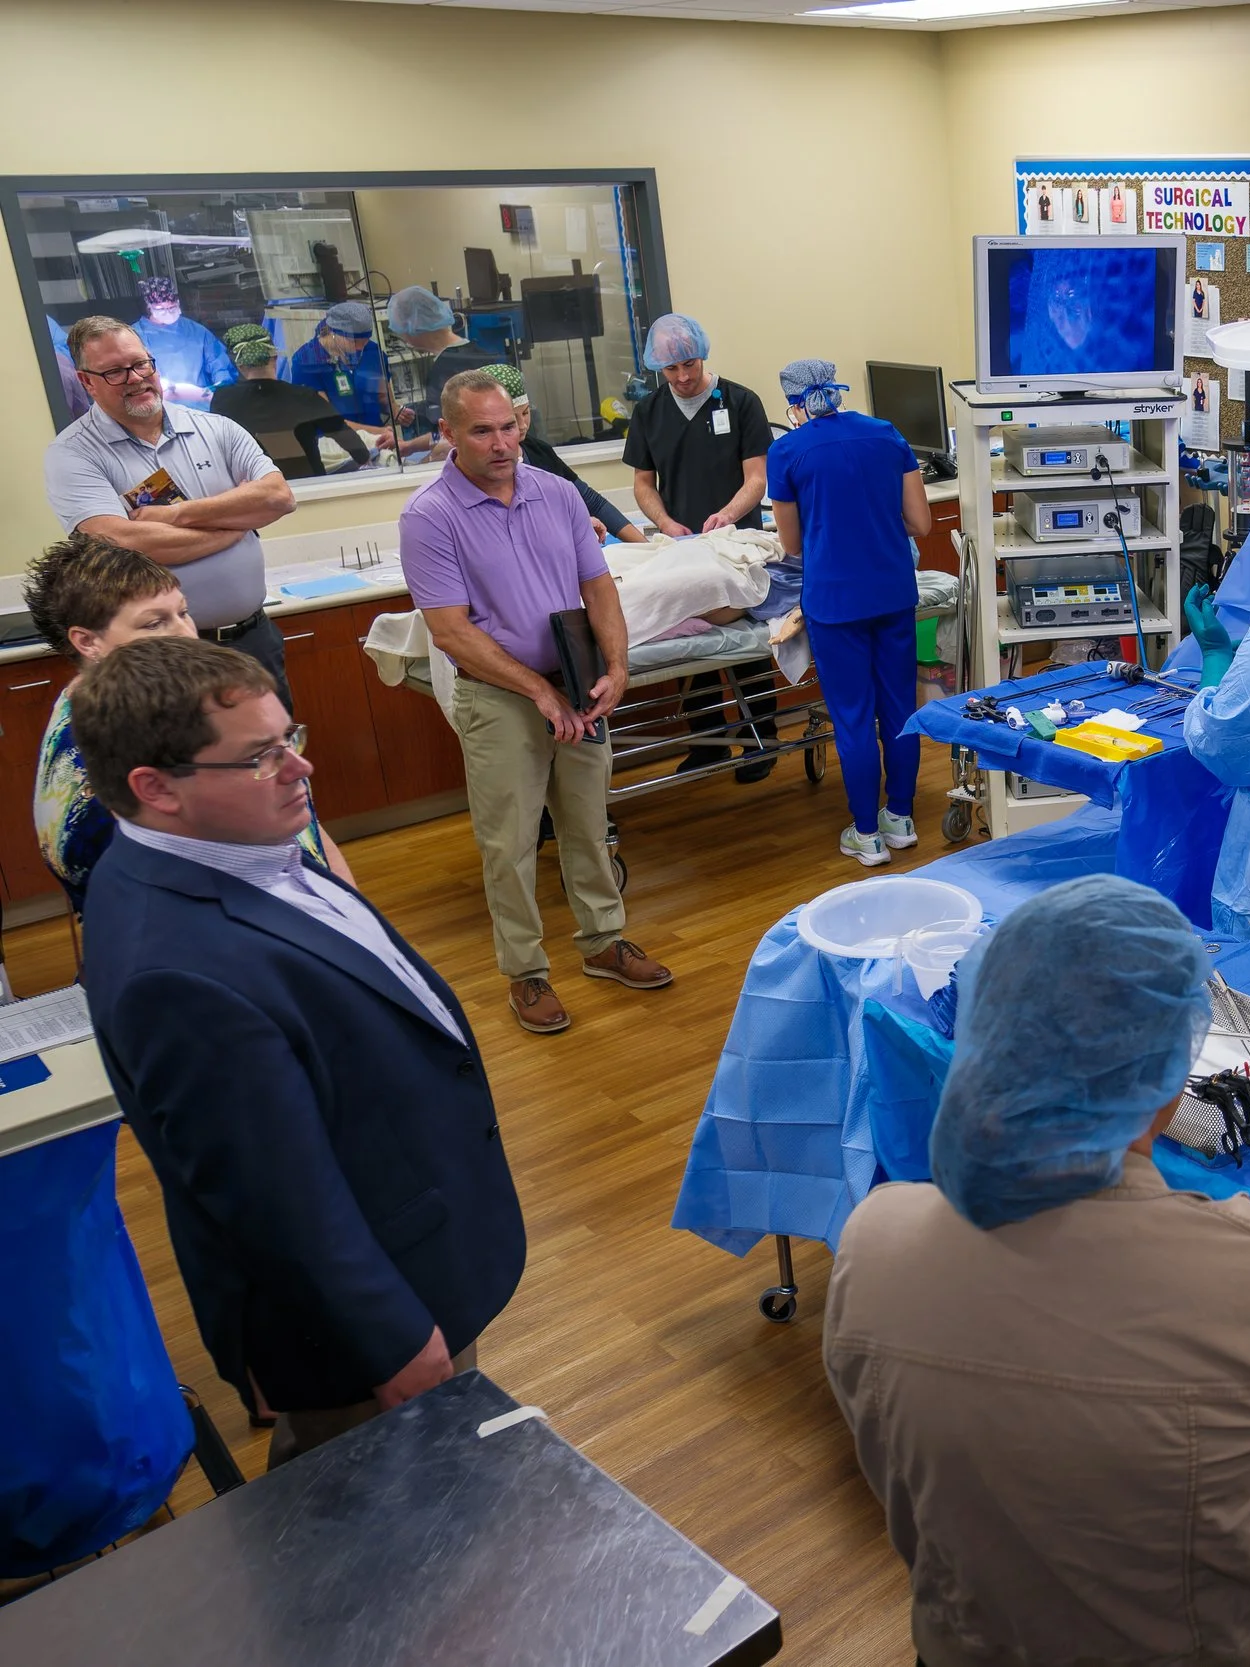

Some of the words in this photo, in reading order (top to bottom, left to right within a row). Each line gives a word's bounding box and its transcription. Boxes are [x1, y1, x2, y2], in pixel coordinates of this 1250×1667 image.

[1154, 187, 1233, 207] SURGICAL
[1146, 211, 1247, 235] TECHNOLOGY
[1133, 404, 1173, 414] stryker
